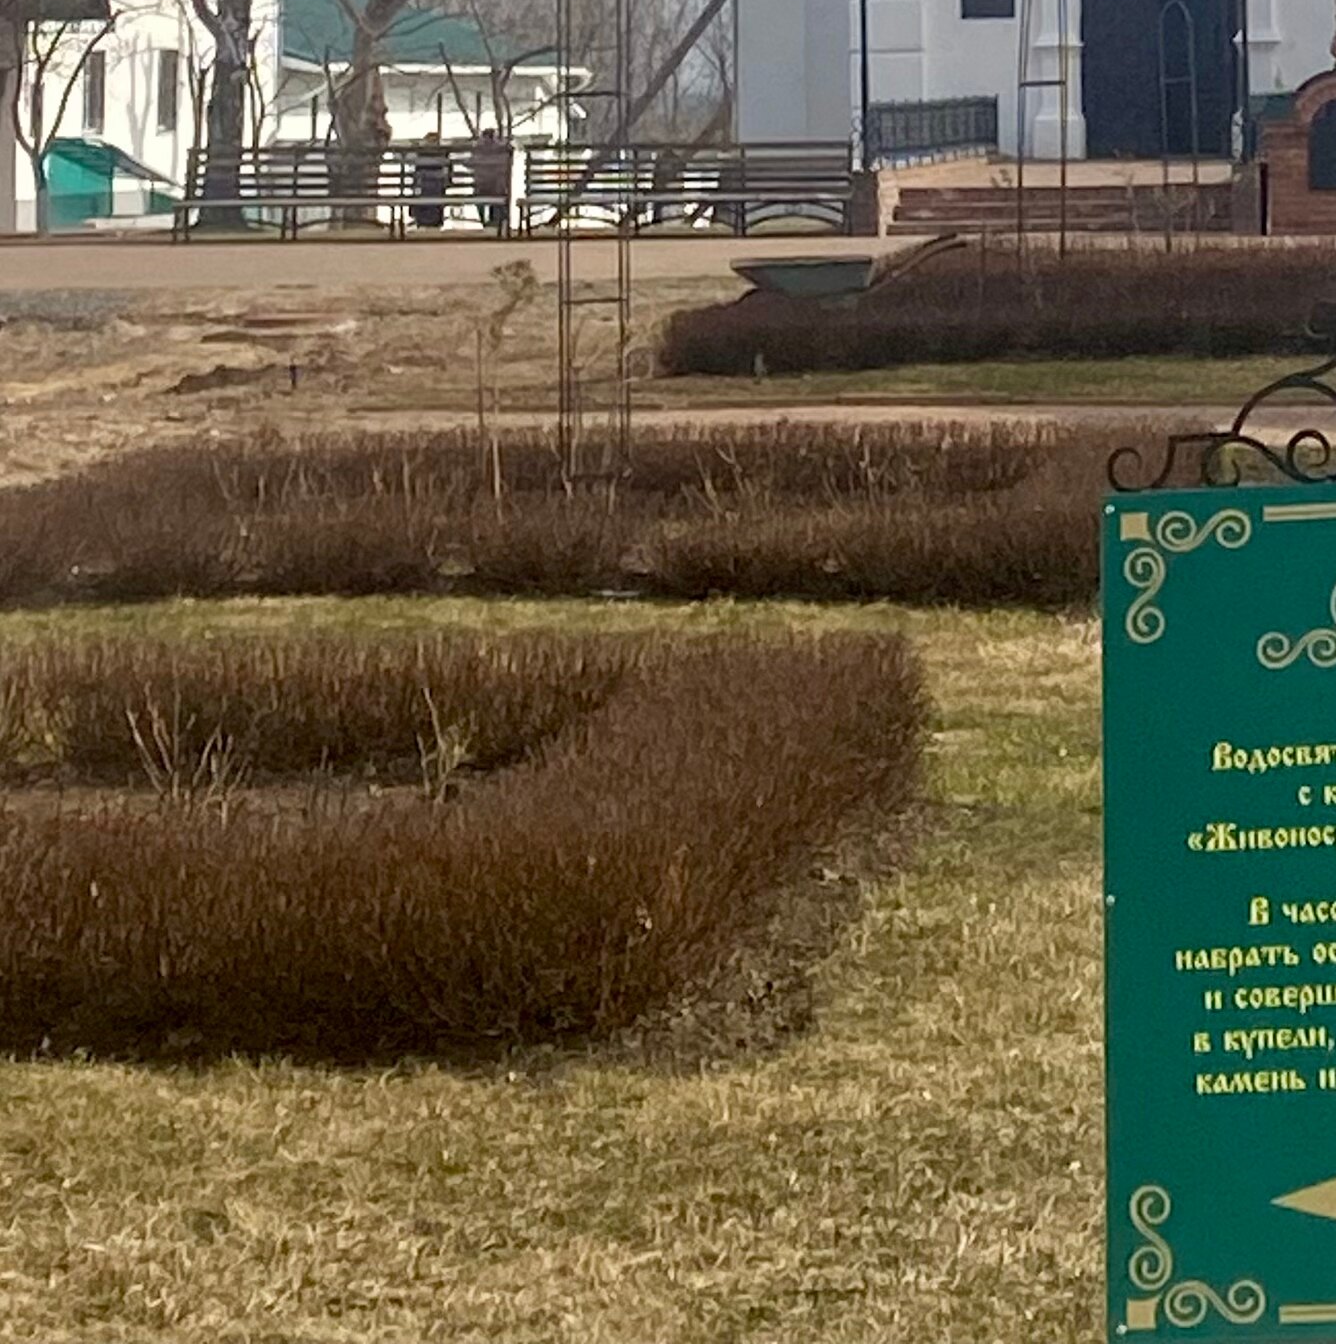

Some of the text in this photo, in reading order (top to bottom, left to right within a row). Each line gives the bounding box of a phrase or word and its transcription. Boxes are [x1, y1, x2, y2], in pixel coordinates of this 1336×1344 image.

[1298, 786, 1311, 806] с
[1249, 896, 1269, 925] В
[1175, 945, 1299, 976] набрать
[1204, 990, 1222, 1010] и
[1194, 1032, 1211, 1052] в
[1224, 1026, 1335, 1060] купели,
[1196, 1070, 1306, 1095] камень
